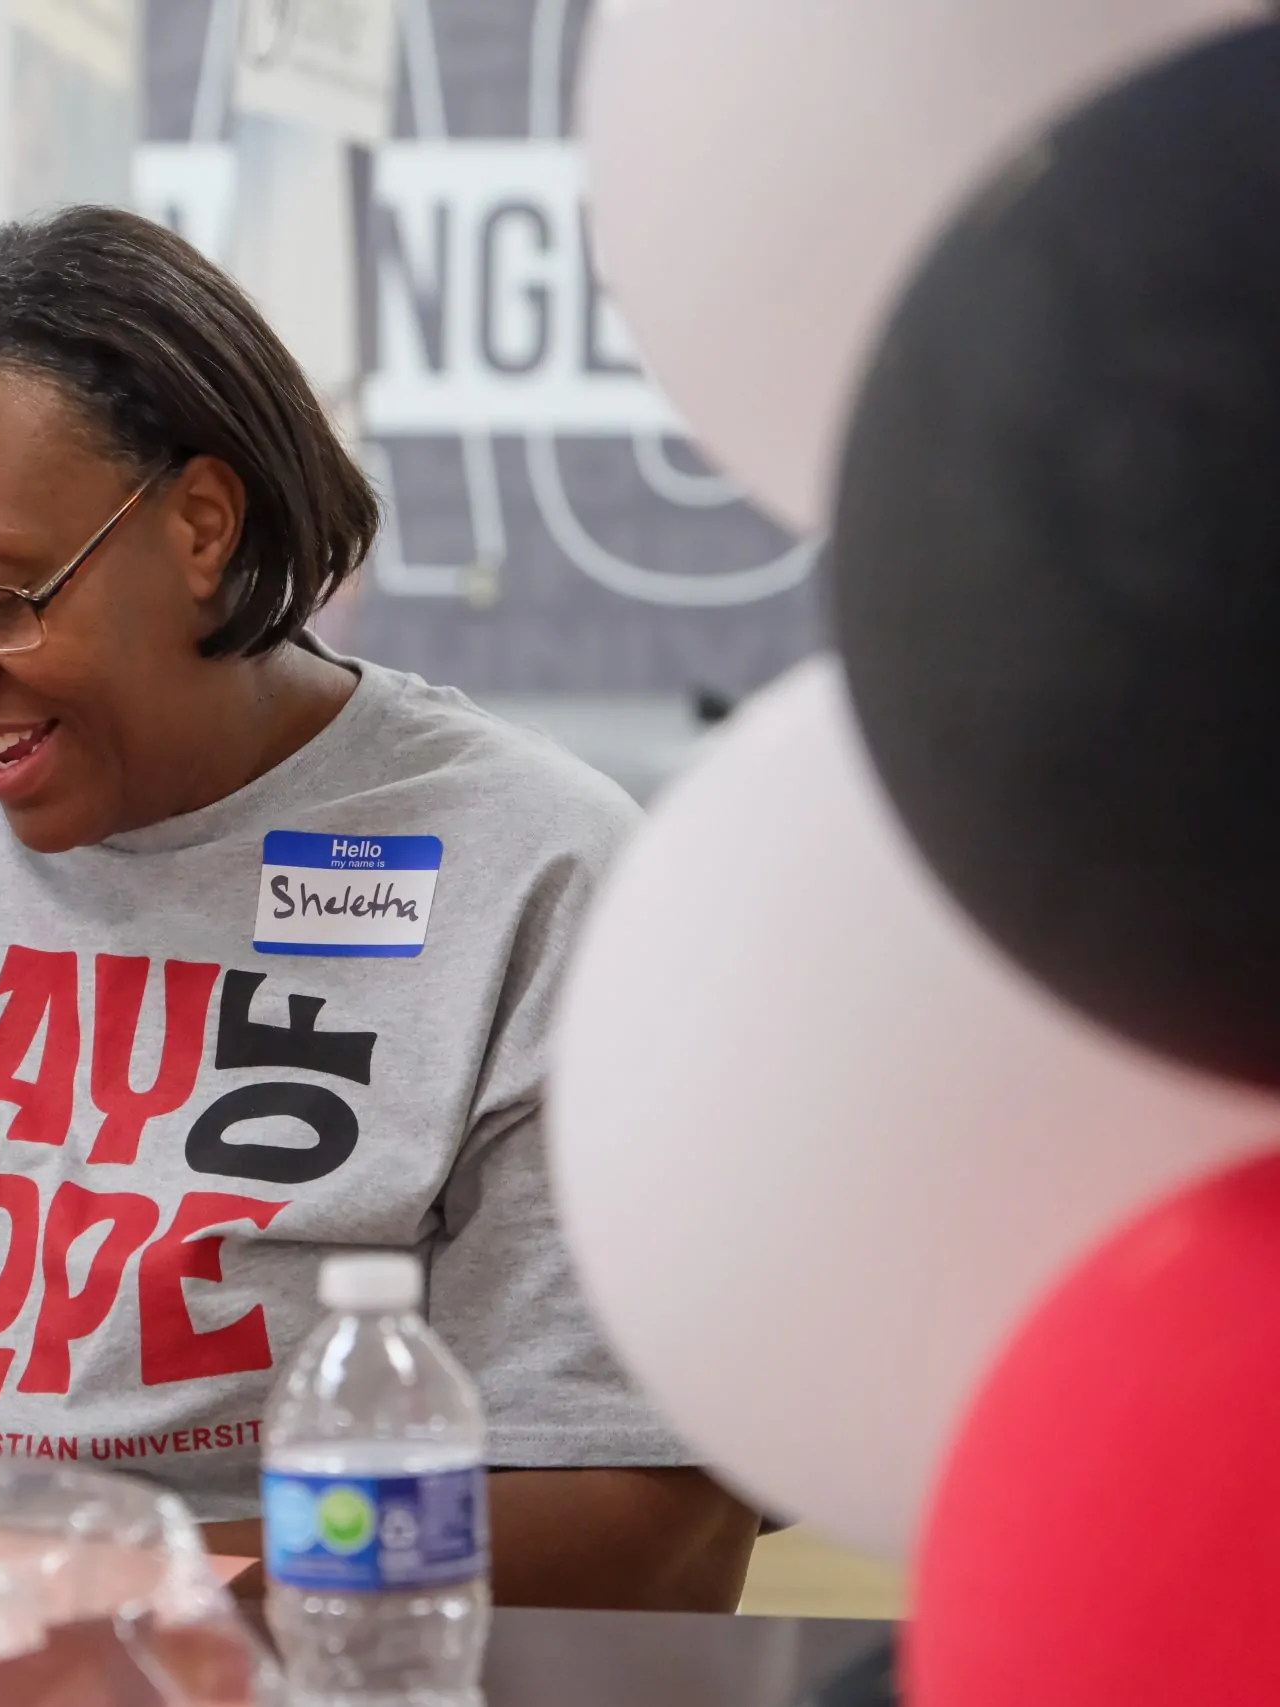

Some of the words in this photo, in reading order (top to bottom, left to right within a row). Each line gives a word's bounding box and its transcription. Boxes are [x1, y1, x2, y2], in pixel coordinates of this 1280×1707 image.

[331, 860, 346, 869] my
[348, 860, 375, 868] name
[376, 859, 385, 868] is
[332, 839, 382, 858] Hello
[270, 875, 419, 922] Sheletha
[185, 968, 378, 1185] OF
[91, 1419, 264, 1461] UNIVERSIT
